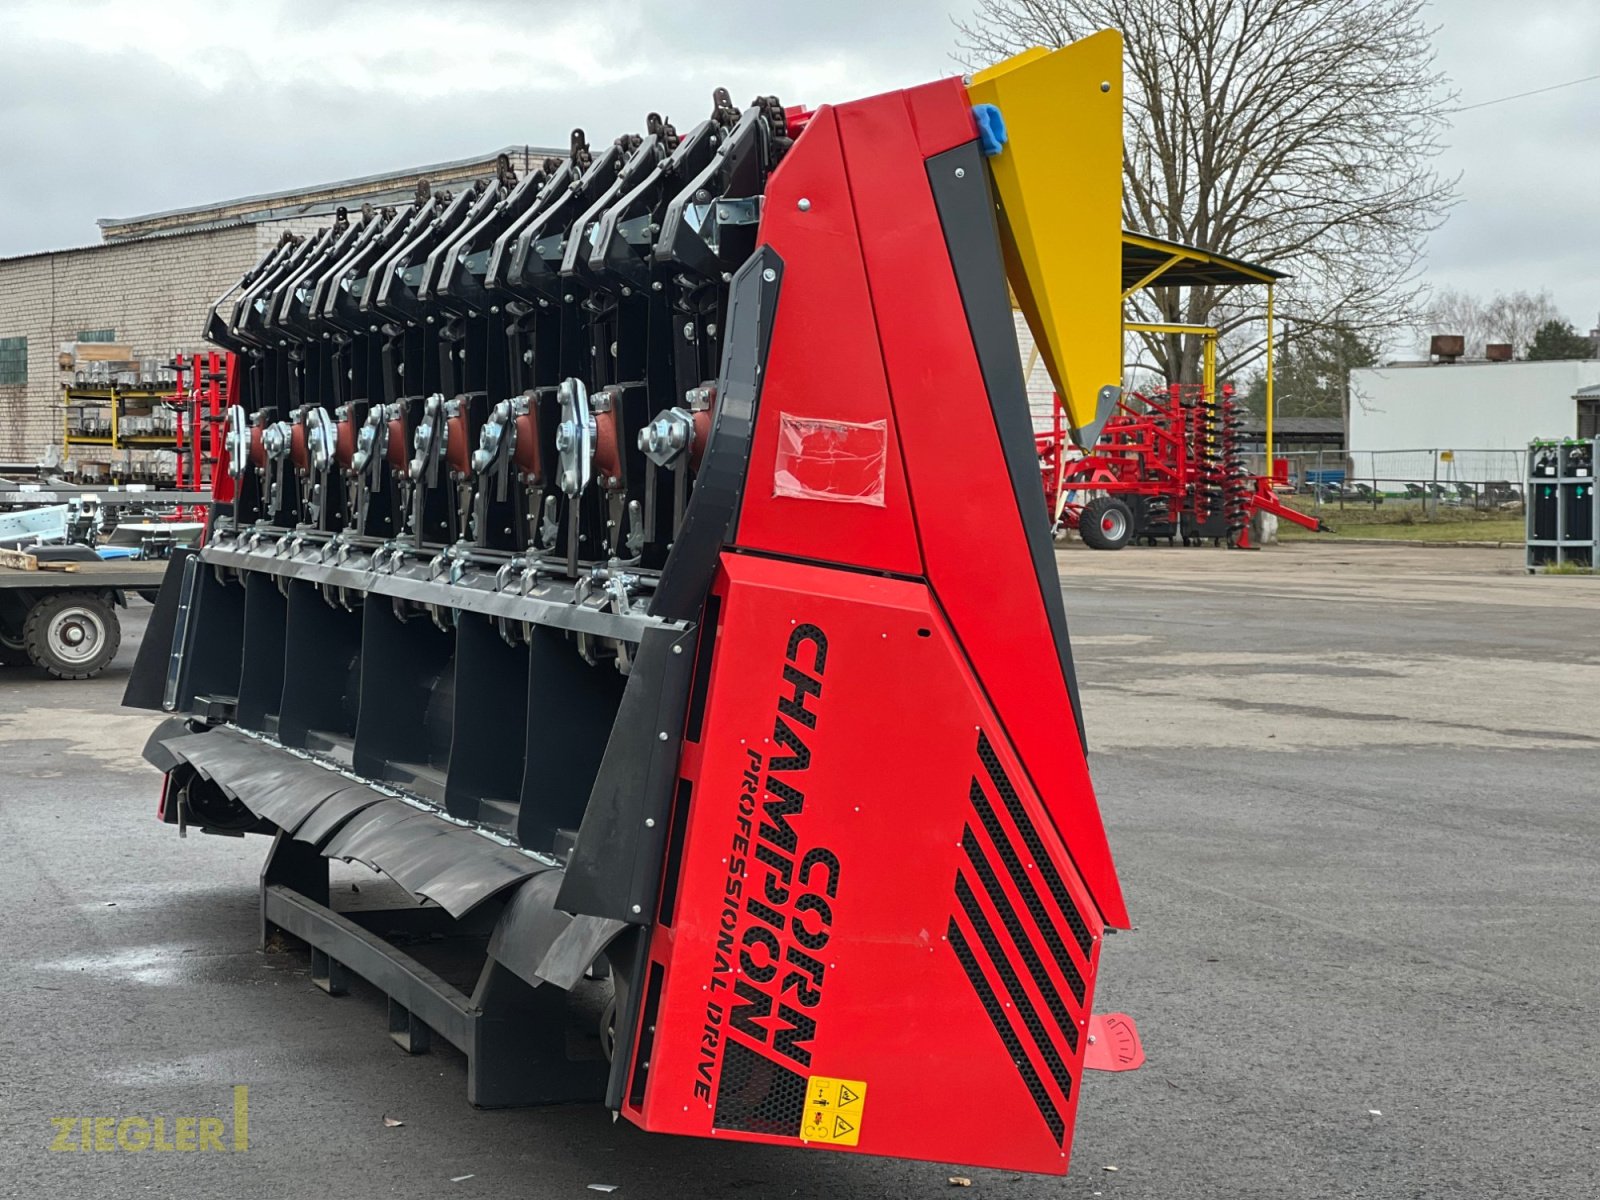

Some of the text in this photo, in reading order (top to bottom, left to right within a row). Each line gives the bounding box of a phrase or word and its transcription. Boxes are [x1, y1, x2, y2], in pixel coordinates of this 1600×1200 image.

[694, 748, 762, 1104] PROFESSIONAL DRIVE
[728, 623, 828, 1044] CHAMPION
[772, 848, 840, 1068] CORN
